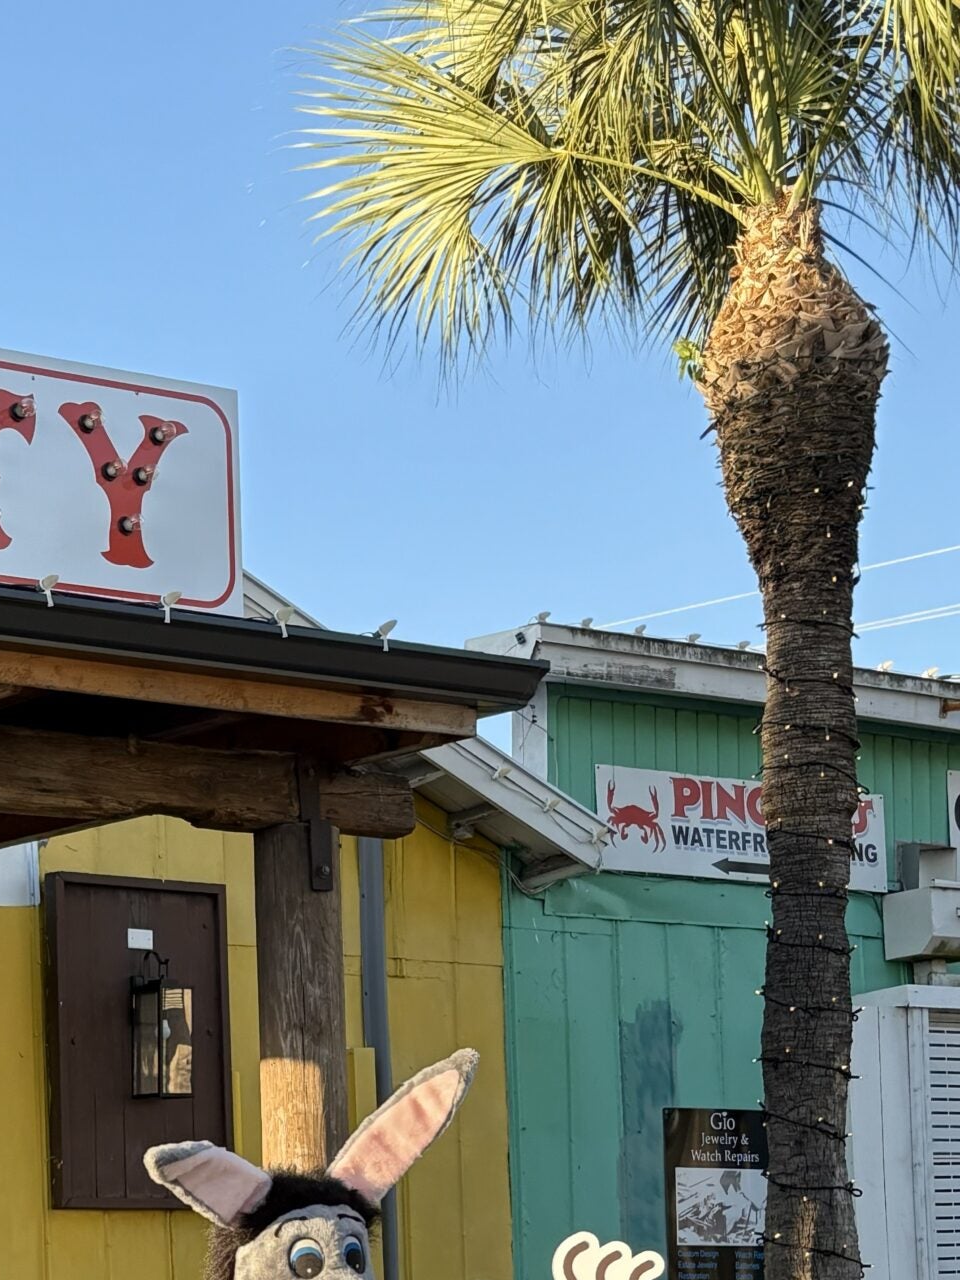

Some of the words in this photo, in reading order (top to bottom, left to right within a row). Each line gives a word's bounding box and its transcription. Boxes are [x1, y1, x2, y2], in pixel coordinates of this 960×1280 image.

[710, 1111, 736, 1130] Gio
[701, 1132, 738, 1148] Jewelry
[740, 1133, 749, 1145] &
[691, 1149, 721, 1161] Watch
[724, 1150, 760, 1165] Repairs
